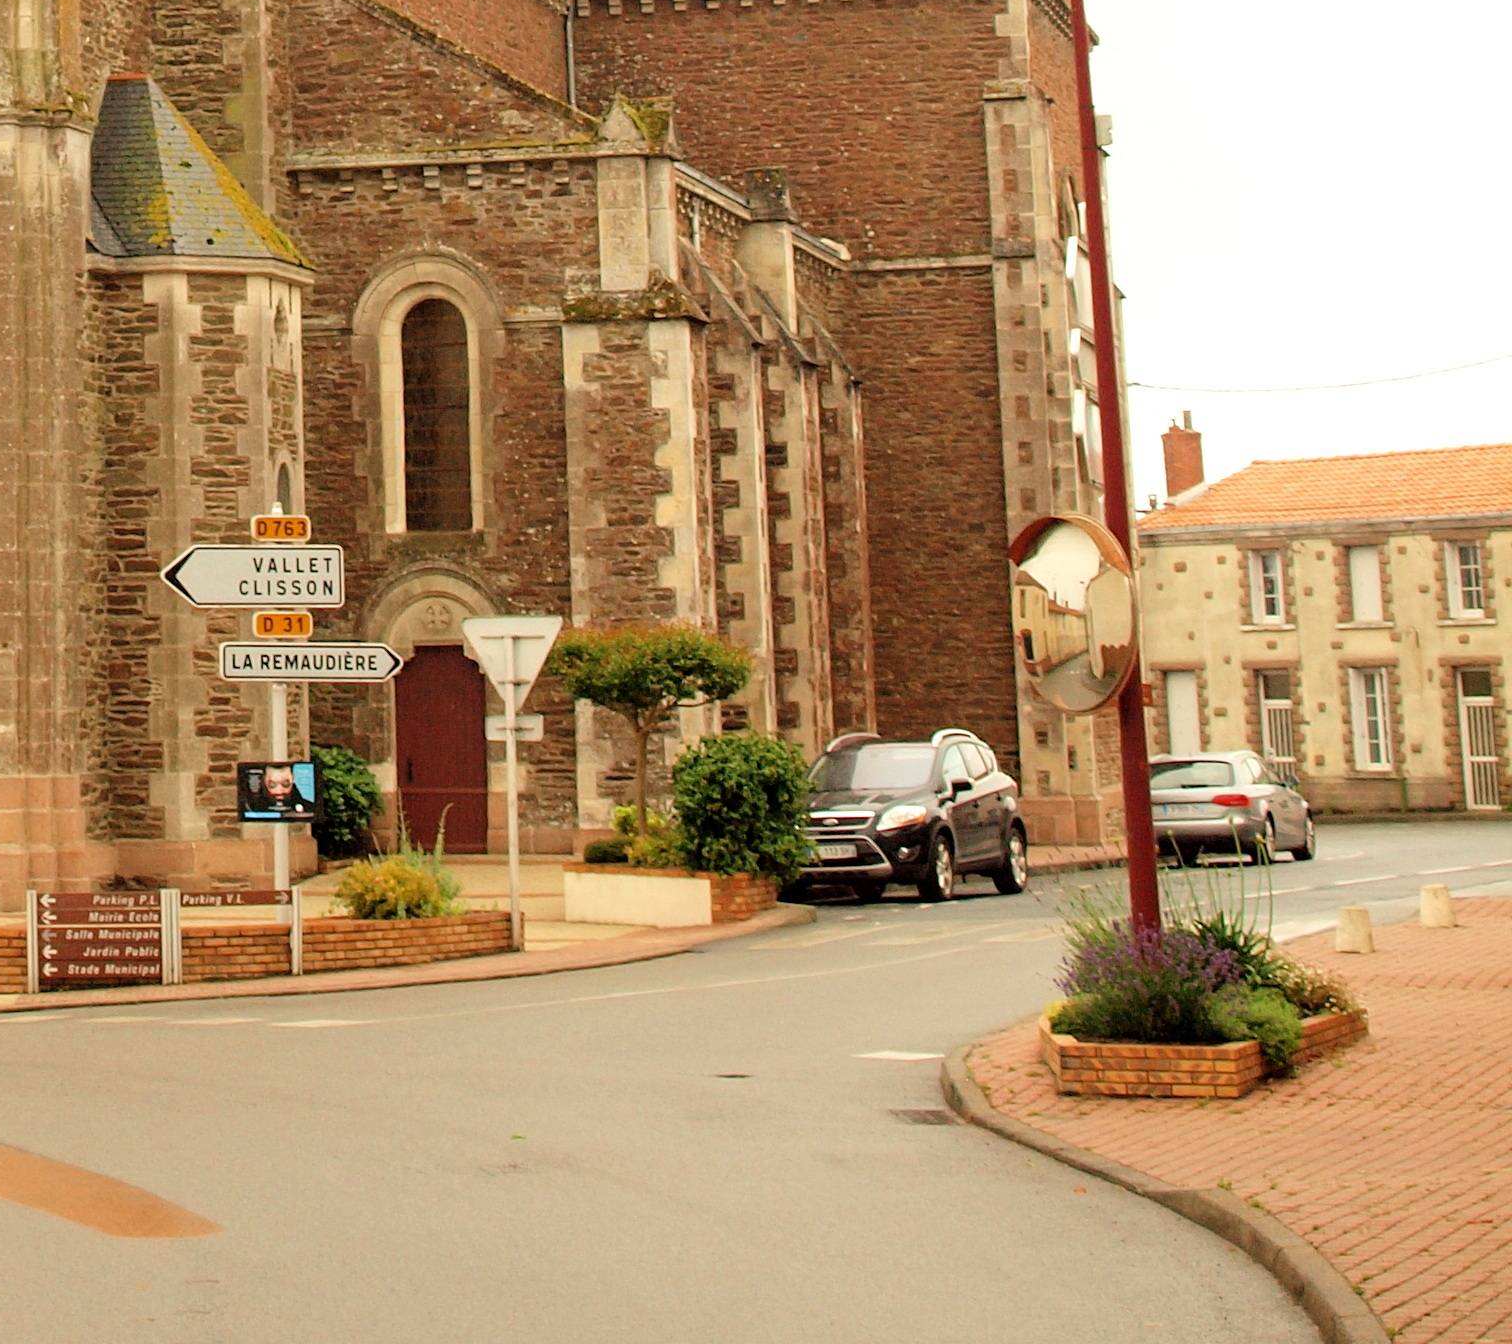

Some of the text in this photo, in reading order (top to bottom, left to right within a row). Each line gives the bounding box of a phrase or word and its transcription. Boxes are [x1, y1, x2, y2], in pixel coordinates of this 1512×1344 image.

[257, 520, 308, 537] D 763
[252, 557, 333, 574] VALLET
[238, 579, 335, 596] CLISSON
[263, 617, 305, 633] D 31
[231, 650, 378, 672] LA REMAUDIÈRE
[92, 894, 135, 907] Parking
[182, 893, 223, 906] Parking
[65, 929, 160, 941] Salle Municipale
[82, 946, 160, 957] Jardin Public
[67, 963, 161, 976] Stade Municipal
